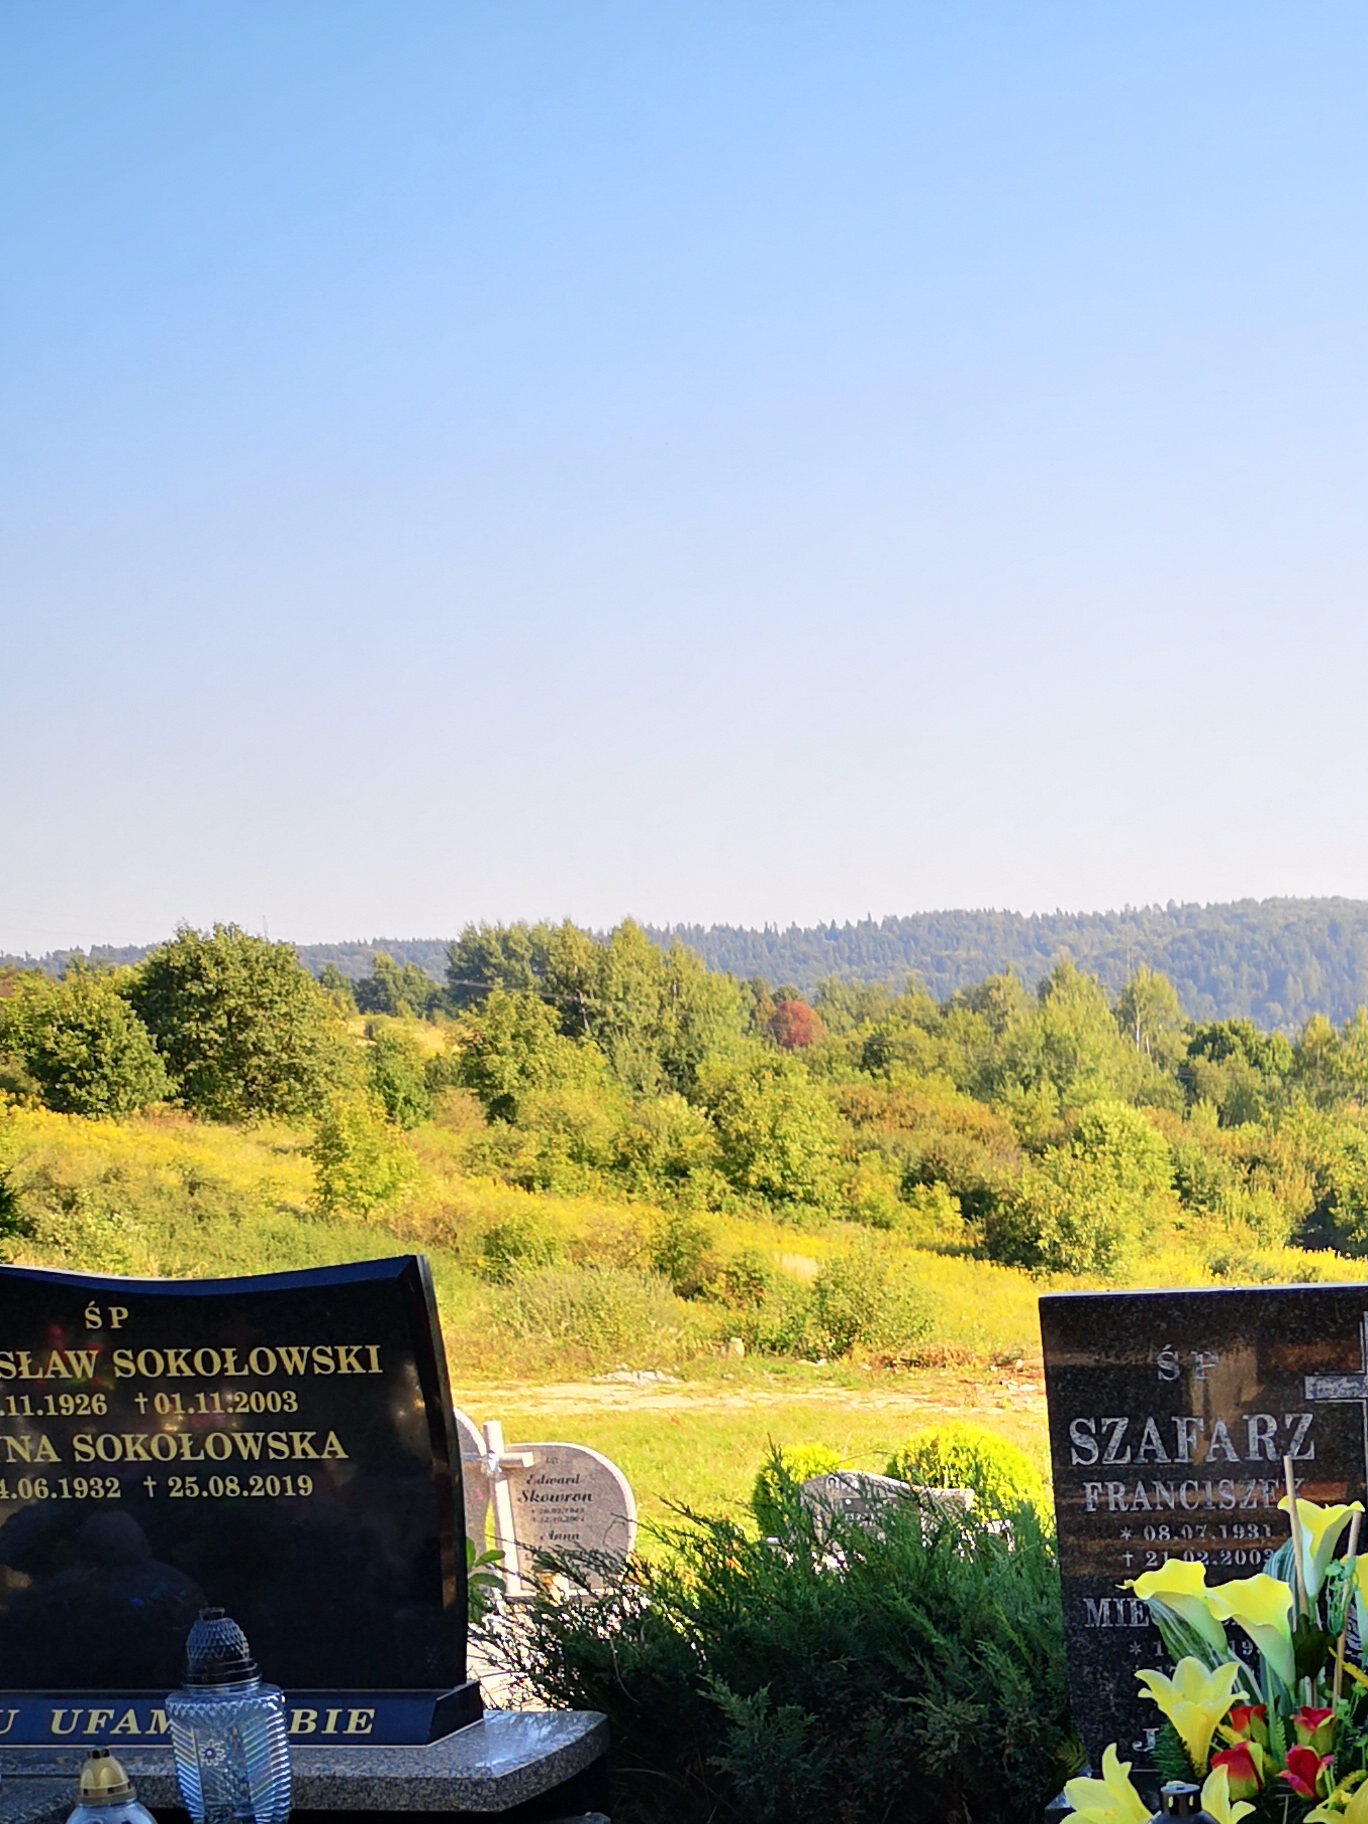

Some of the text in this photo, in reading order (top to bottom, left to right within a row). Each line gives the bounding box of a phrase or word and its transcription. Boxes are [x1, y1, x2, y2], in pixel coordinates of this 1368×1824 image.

[114, 1345, 384, 1378] SOKOŁOWSKI
[154, 1390, 298, 1415] 01.11.2003
[0, 1430, 349, 1463] NA SOKOŁOWSKA
[1069, 1413, 1315, 1466] SZAFARZ
[168, 1475, 313, 1498] 25.08.2019
[526, 1473, 580, 1485] Edward
[518, 1489, 593, 1503] Skowron
[1143, 1523, 1273, 1542] 08.07.1931
